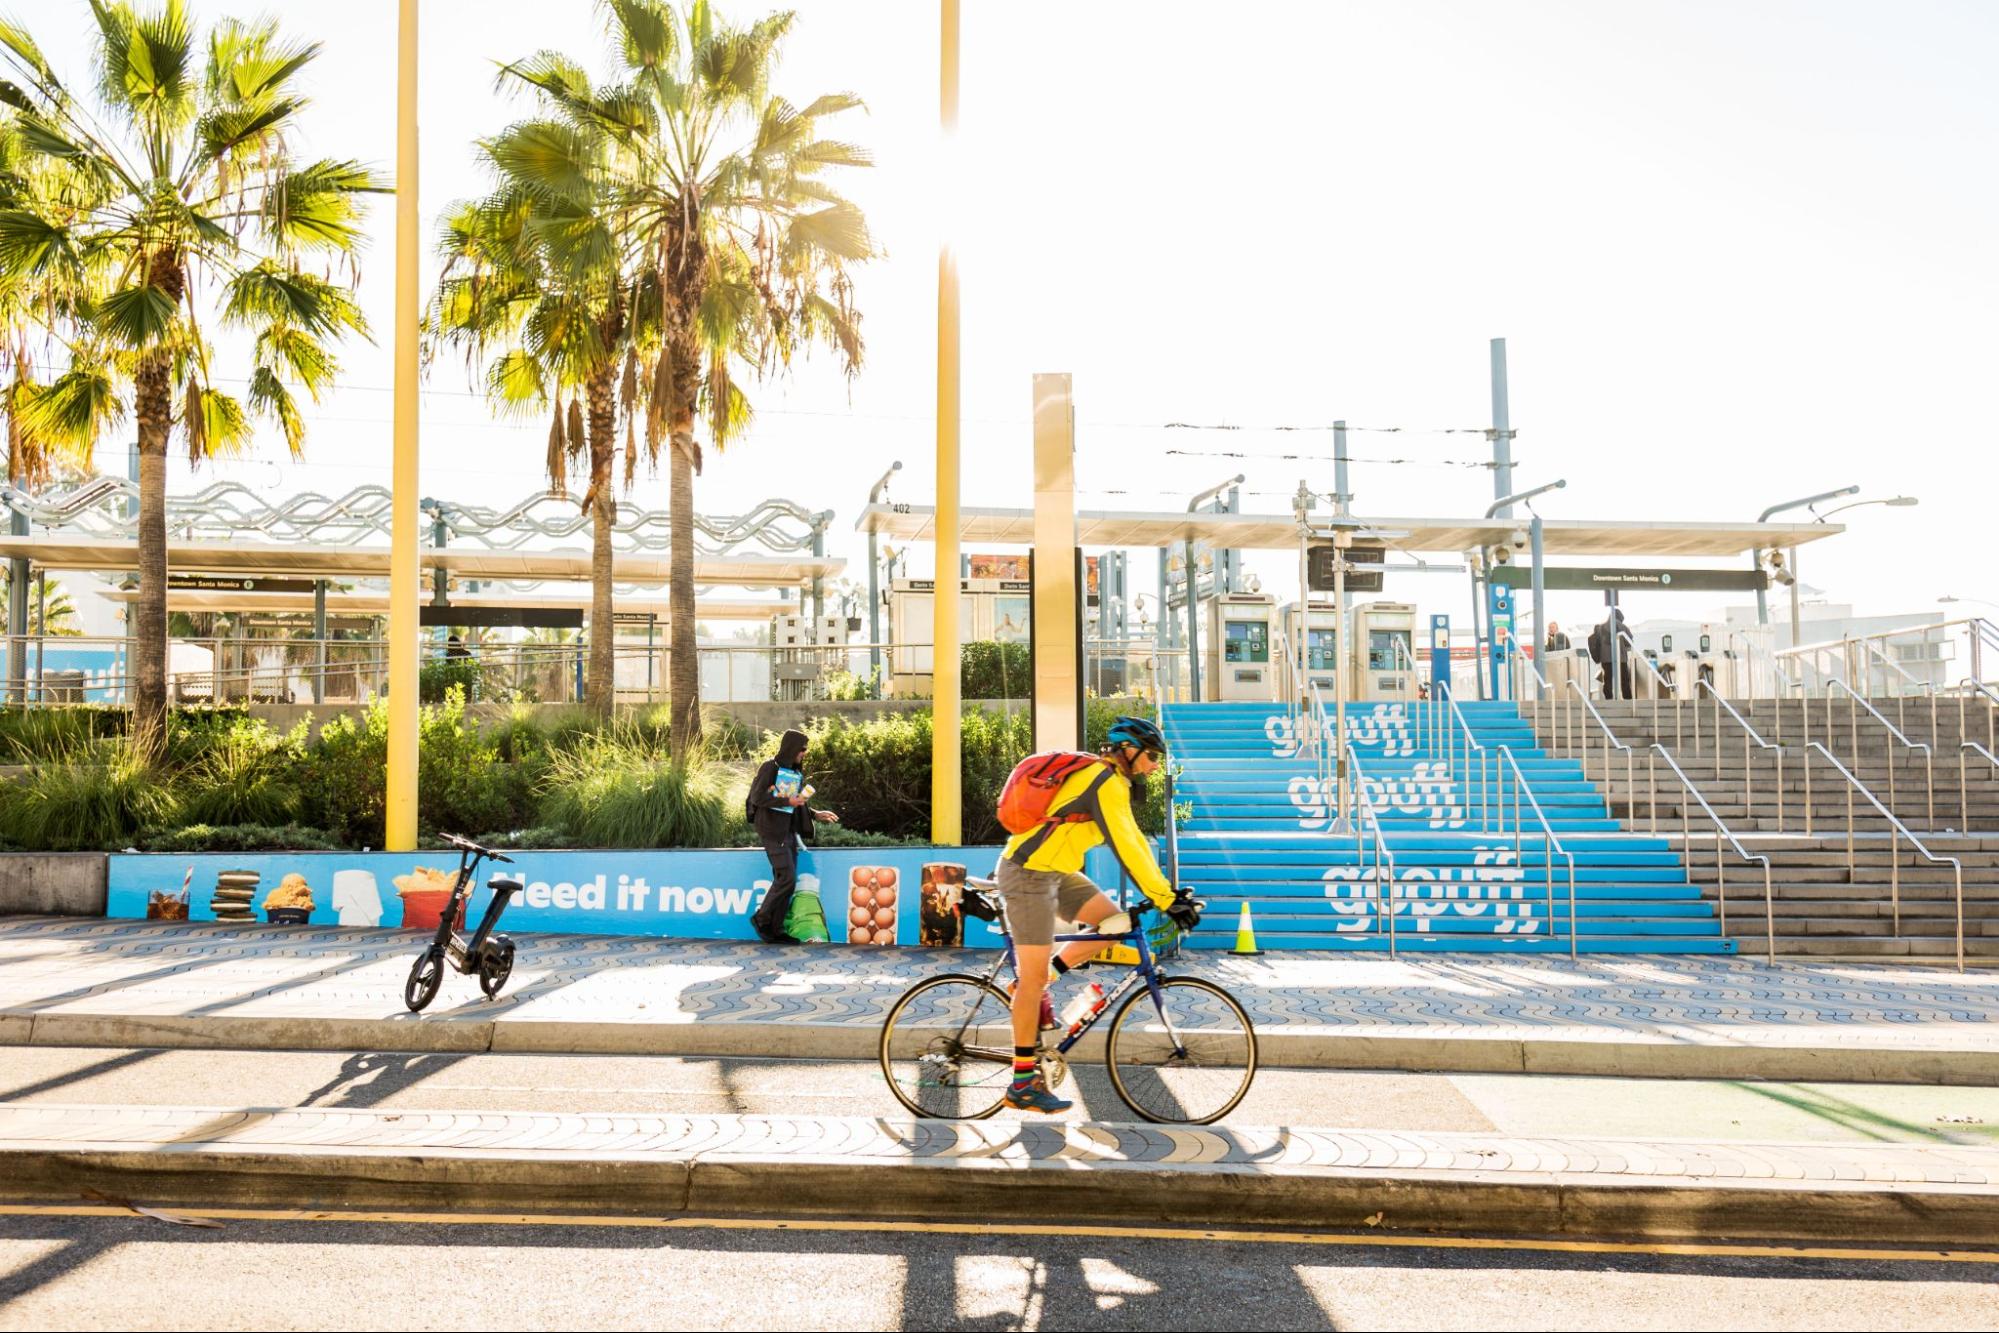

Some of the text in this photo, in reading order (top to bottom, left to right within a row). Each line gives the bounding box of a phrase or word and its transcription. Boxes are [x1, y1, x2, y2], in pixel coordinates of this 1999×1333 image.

[893, 504, 911, 514] 402
[1593, 574, 1622, 582] Downtown
[1287, 762, 1466, 828] gopuff
[491, 872, 773, 914] Need it now?
[1321, 846, 1541, 943] gopuff
